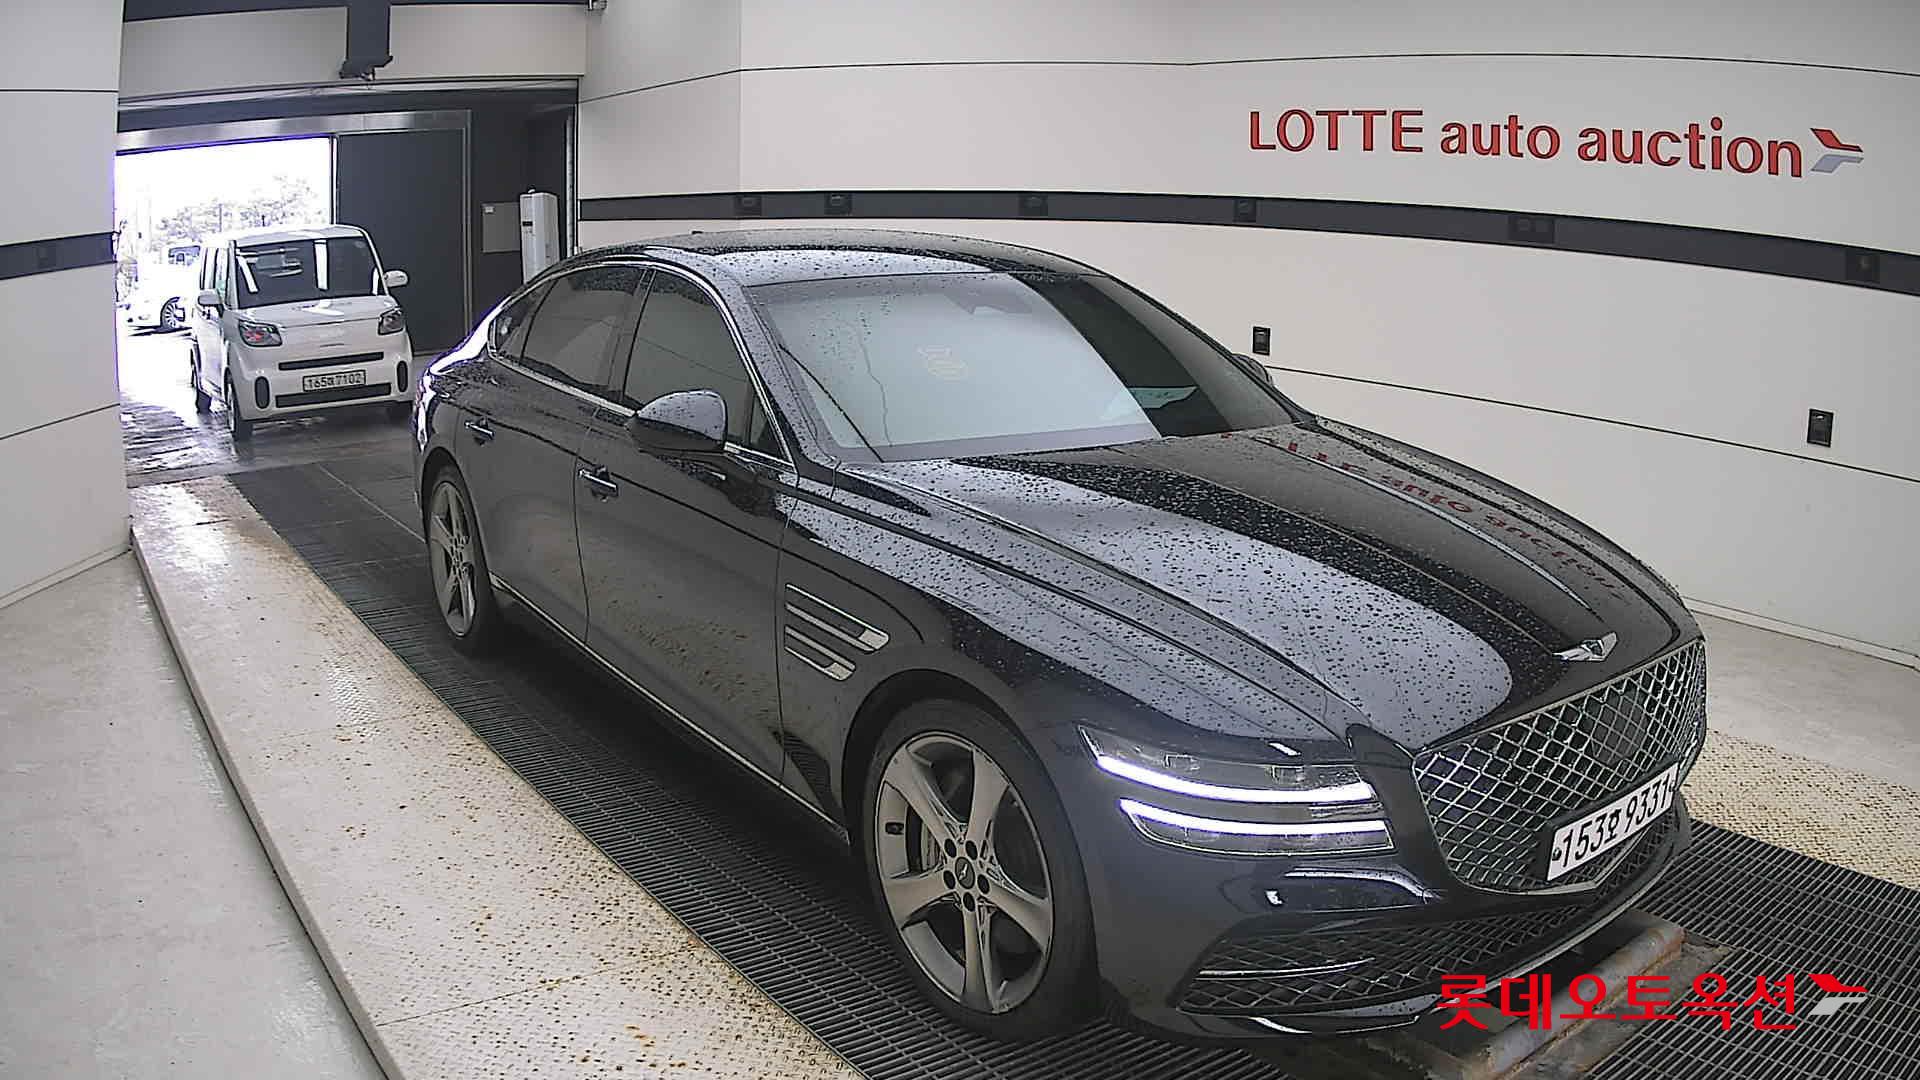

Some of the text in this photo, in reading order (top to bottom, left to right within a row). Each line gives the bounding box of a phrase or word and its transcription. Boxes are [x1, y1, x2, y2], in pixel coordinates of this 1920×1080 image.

[1249, 109, 1803, 178] LOTTE auto auction
